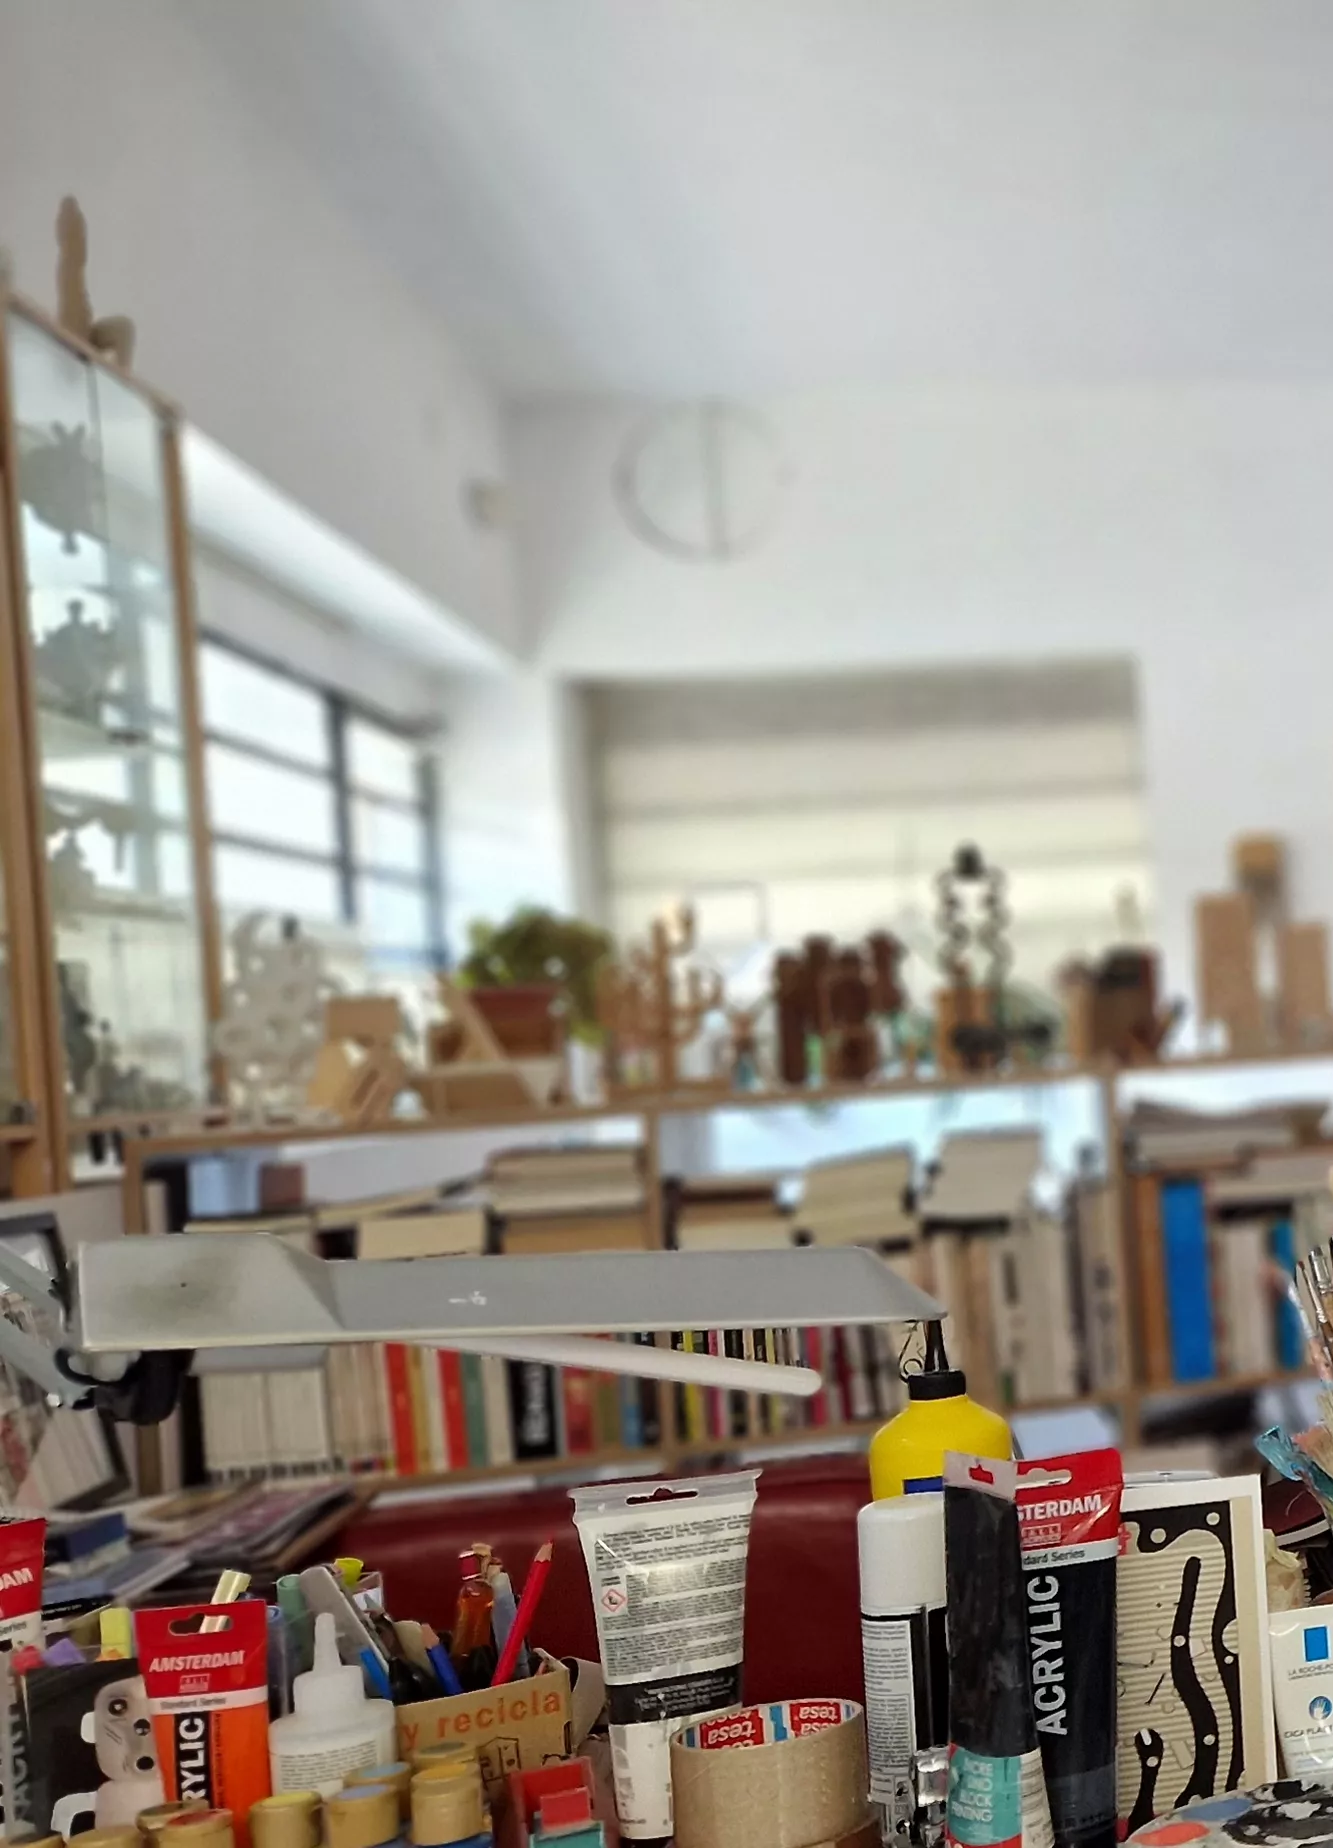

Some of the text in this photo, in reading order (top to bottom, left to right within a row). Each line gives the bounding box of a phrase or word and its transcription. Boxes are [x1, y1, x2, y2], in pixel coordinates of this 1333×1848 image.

[149, 1650, 245, 1672] AMSTERDAM
[1027, 1575, 1068, 1735] ACRYLIC
[403, 1690, 561, 1747] y recicla
[799, 1705, 838, 1720] tesa
[707, 1720, 757, 1745] tesa
